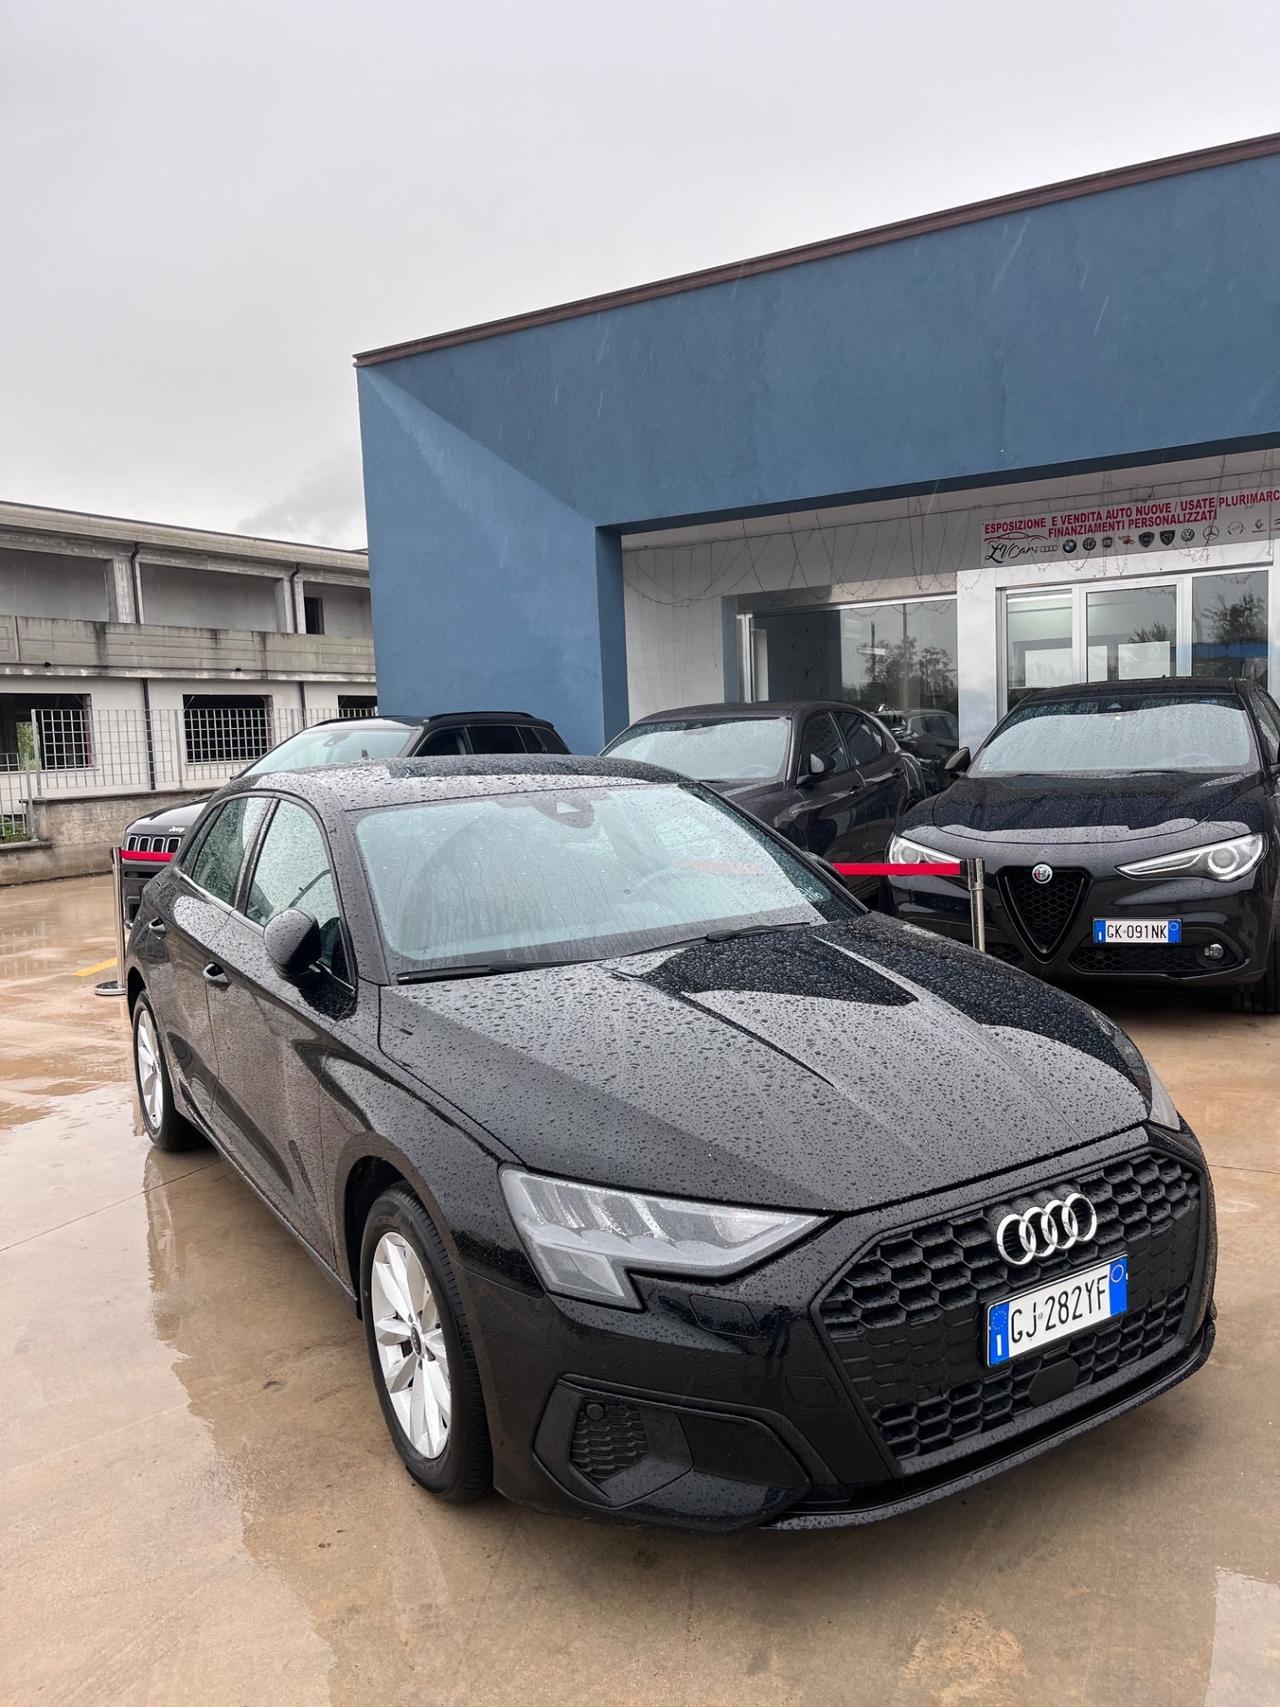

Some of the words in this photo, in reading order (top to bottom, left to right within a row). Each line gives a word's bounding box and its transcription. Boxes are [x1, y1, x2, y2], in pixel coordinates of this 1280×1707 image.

[985, 518, 1046, 534] ESPOSIZIONE
[1052, 516, 1058, 526] E
[1060, 511, 1102, 525] VENDITA
[1106, 507, 1132, 520] AUTO
[1136, 503, 1171, 517] NUOVE
[1180, 497, 1215, 511] USATE
[1048, 520, 1125, 538] FINANZIAMENTI
[1128, 510, 1217, 529] PERSONALIZZATI
